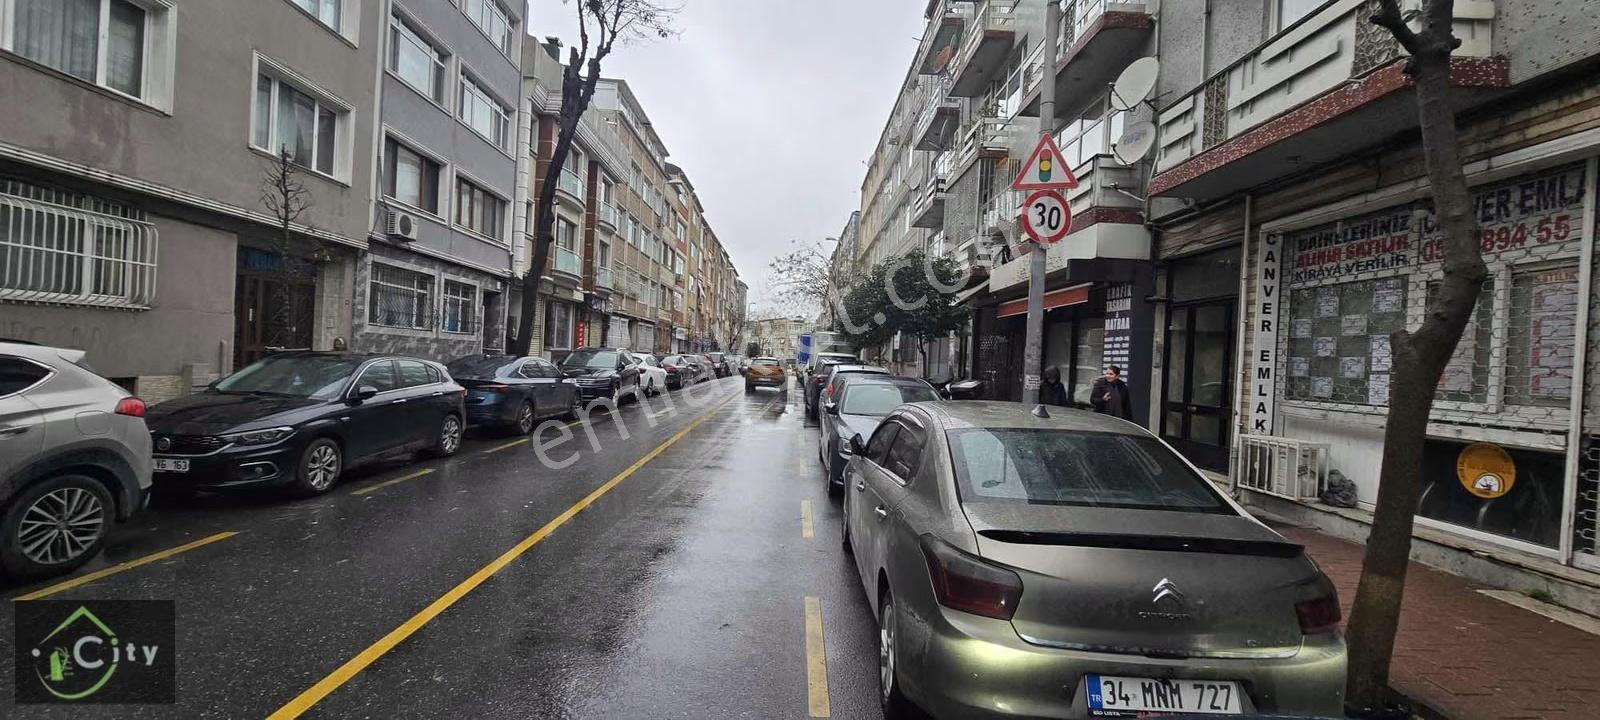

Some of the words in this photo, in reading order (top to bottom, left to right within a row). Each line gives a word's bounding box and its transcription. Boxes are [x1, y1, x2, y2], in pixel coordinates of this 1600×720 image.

[1519, 173, 1586, 215] EMLA
[1034, 202, 1061, 231] 30
[1481, 222, 1527, 252] 894
[1536, 214, 1571, 244] 55
[1261, 233, 1276, 332] CANVER
[1255, 349, 1271, 431] EMLAK
[173, 460, 187, 470] 163
[1090, 694, 1102, 703] TR
[1103, 680, 1130, 707] 34
[1141, 681, 1183, 710] MNM
[1192, 683, 1232, 711] 727
